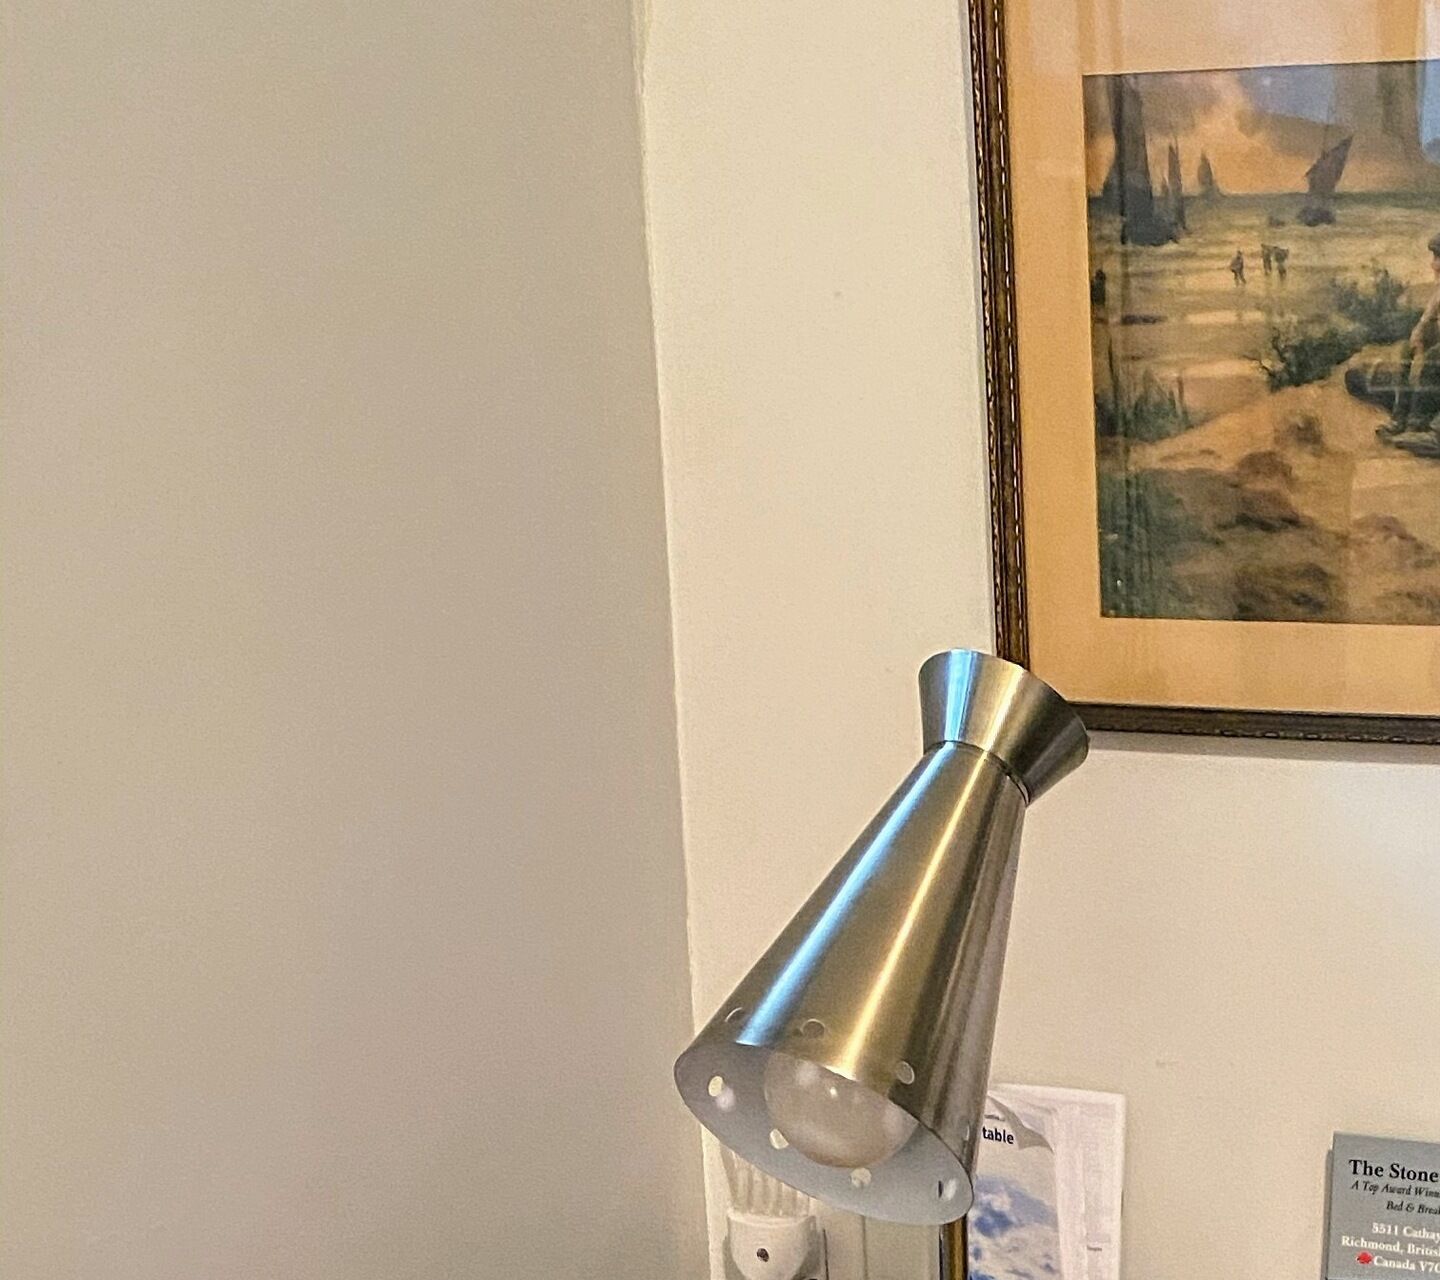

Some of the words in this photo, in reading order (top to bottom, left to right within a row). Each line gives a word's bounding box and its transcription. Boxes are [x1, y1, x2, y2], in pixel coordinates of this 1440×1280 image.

[1349, 1159, 1384, 1177] The
[1389, 1163, 1439, 1183] Stone
[1351, 1181, 1359, 1190] A
[1363, 1181, 1379, 1195] Top
[1381, 1184, 1411, 1196] Award
[1386, 1201, 1403, 1212] Bed
[1405, 1203, 1415, 1213] &
[1341, 1236, 1404, 1254] Richmond,
[1373, 1256, 1415, 1271] Canada
